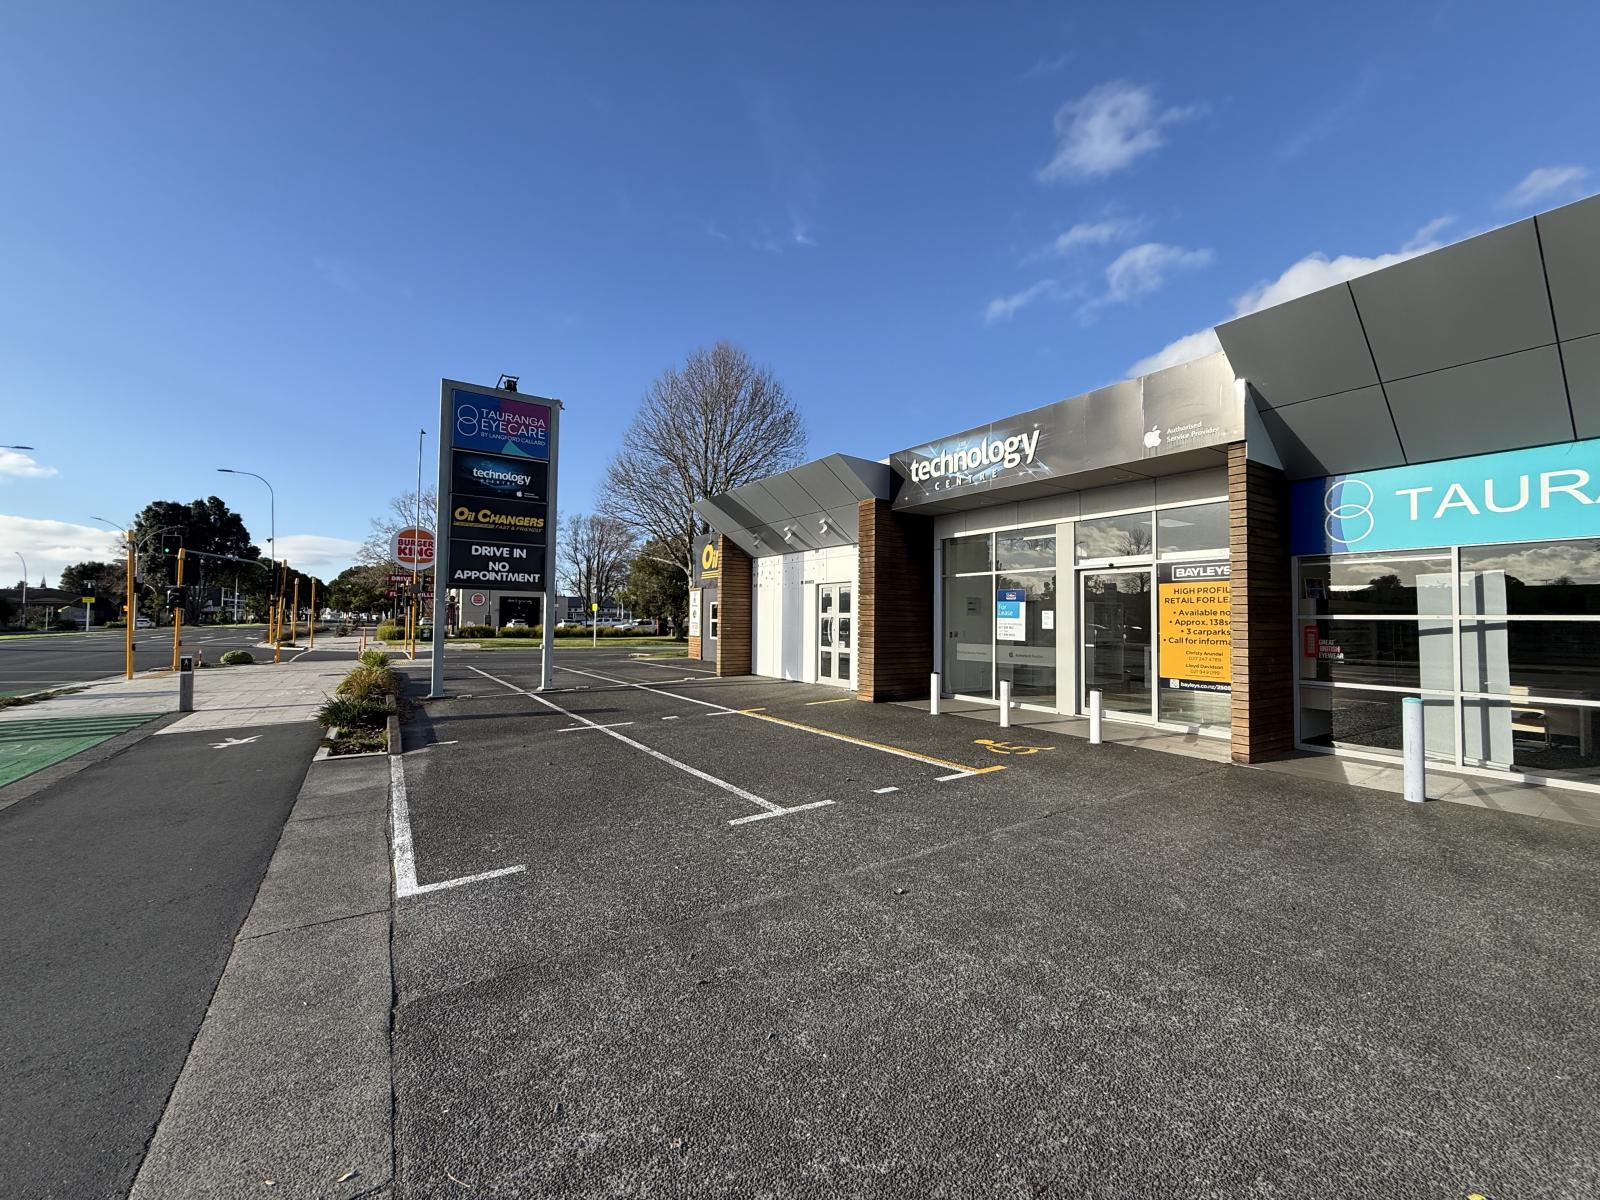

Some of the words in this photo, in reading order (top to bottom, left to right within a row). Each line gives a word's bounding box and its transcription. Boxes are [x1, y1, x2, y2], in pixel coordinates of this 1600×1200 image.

[481, 408, 546, 428] TAURANGA
[481, 418, 546, 440] EYECARE
[1166, 421, 1202, 435] Authorised
[1166, 433, 1190, 443] Service
[1191, 427, 1219, 437] Provider
[910, 430, 1041, 482] technology
[473, 467, 531, 485] technology
[934, 468, 998, 490] CENTRE
[1395, 468, 1600, 521] TAUR
[478, 509, 545, 527] CHANGERS
[398, 539, 434, 548] BURGER
[398, 546, 434, 557] KING
[472, 545, 510, 557] DRIVE
[513, 548, 527, 558] IN
[488, 561, 510, 571] NO
[1175, 565, 1231, 577] BAYLEYS
[454, 570, 540, 583] APPOINTMENT
[1173, 587, 1195, 595] HIGH
[1196, 596, 1216, 604] FOR
[1175, 618, 1208, 627] Approx.
[1192, 628, 1231, 636] carparks
